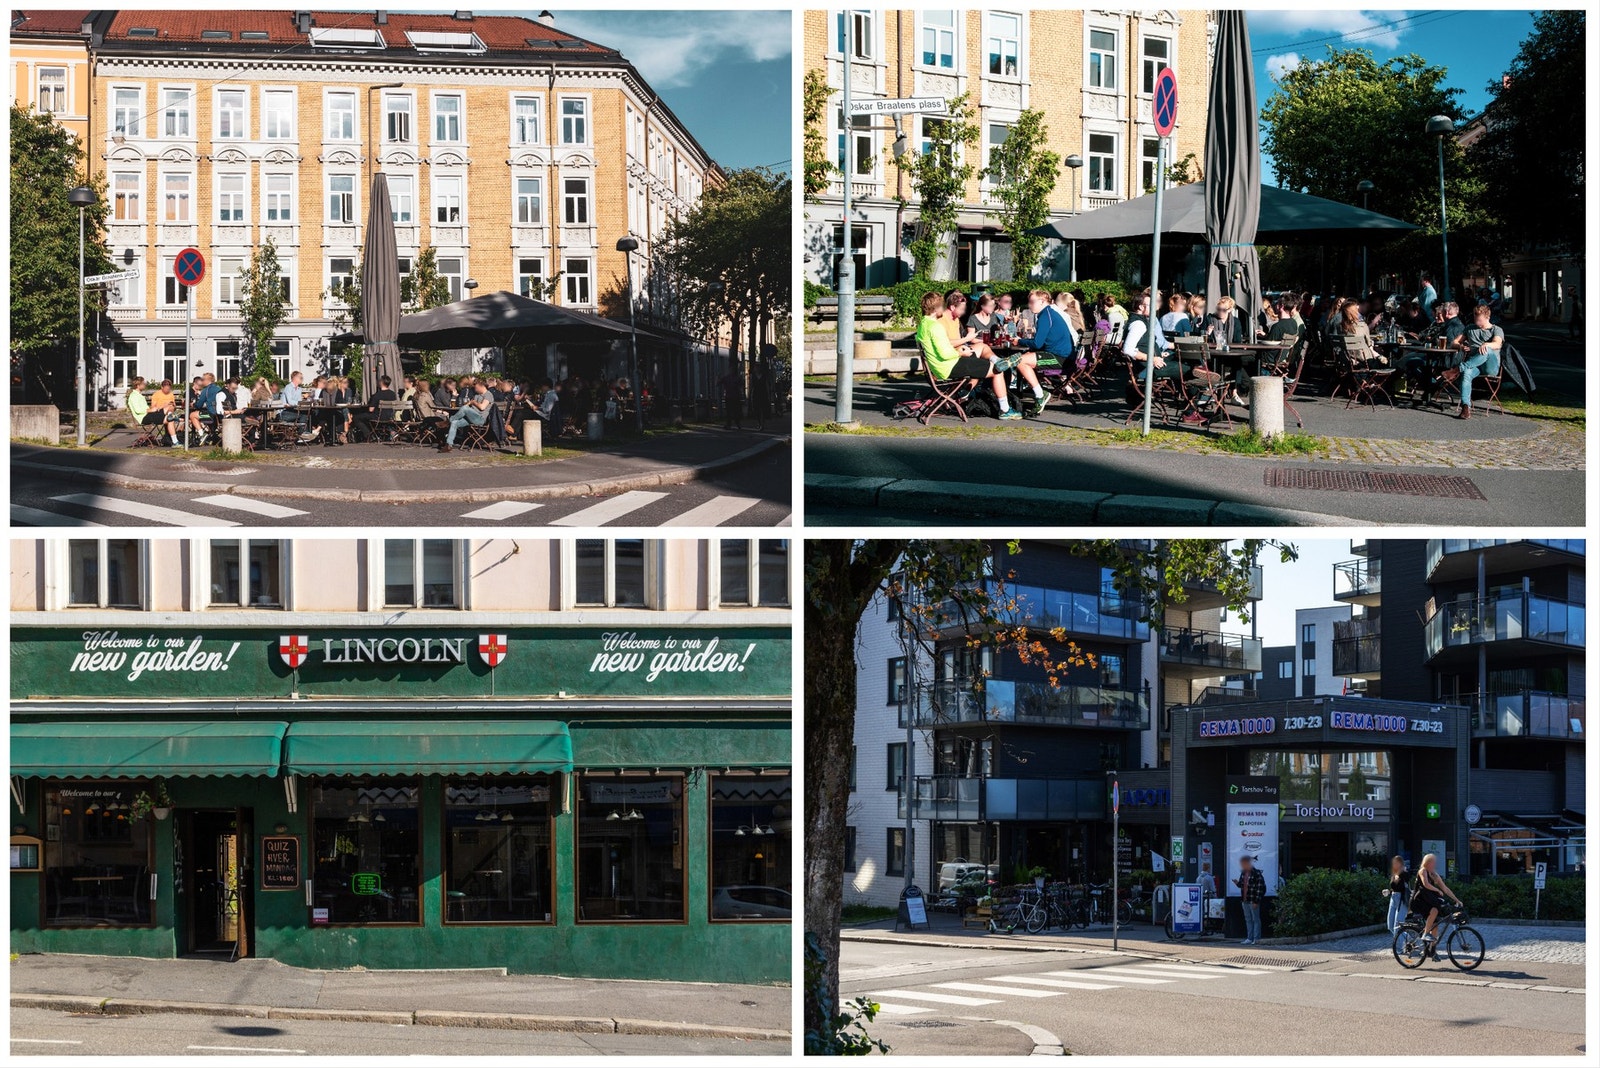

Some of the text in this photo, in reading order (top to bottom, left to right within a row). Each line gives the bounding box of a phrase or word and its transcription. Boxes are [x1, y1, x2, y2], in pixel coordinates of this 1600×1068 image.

[877, 100, 916, 110] Braatens
[919, 100, 941, 109] plass
[82, 630, 185, 650] Welcome to our
[601, 632, 702, 651] Welcome to our
[70, 635, 241, 682] new garden!
[322, 638, 465, 663] LINCOLN
[589, 636, 757, 683] new garden!
[1200, 715, 1323, 737] REMA 1000 7.30-23
[1330, 711, 1443, 733] REMA 1000 7.30-23
[60, 789, 93, 797] Welcome
[1241, 784, 1277, 795] Torshov Torg
[1294, 803, 1374, 820] Torshov Torg
[267, 841, 290, 851] QUIZ
[1537, 864, 1545, 878] P
